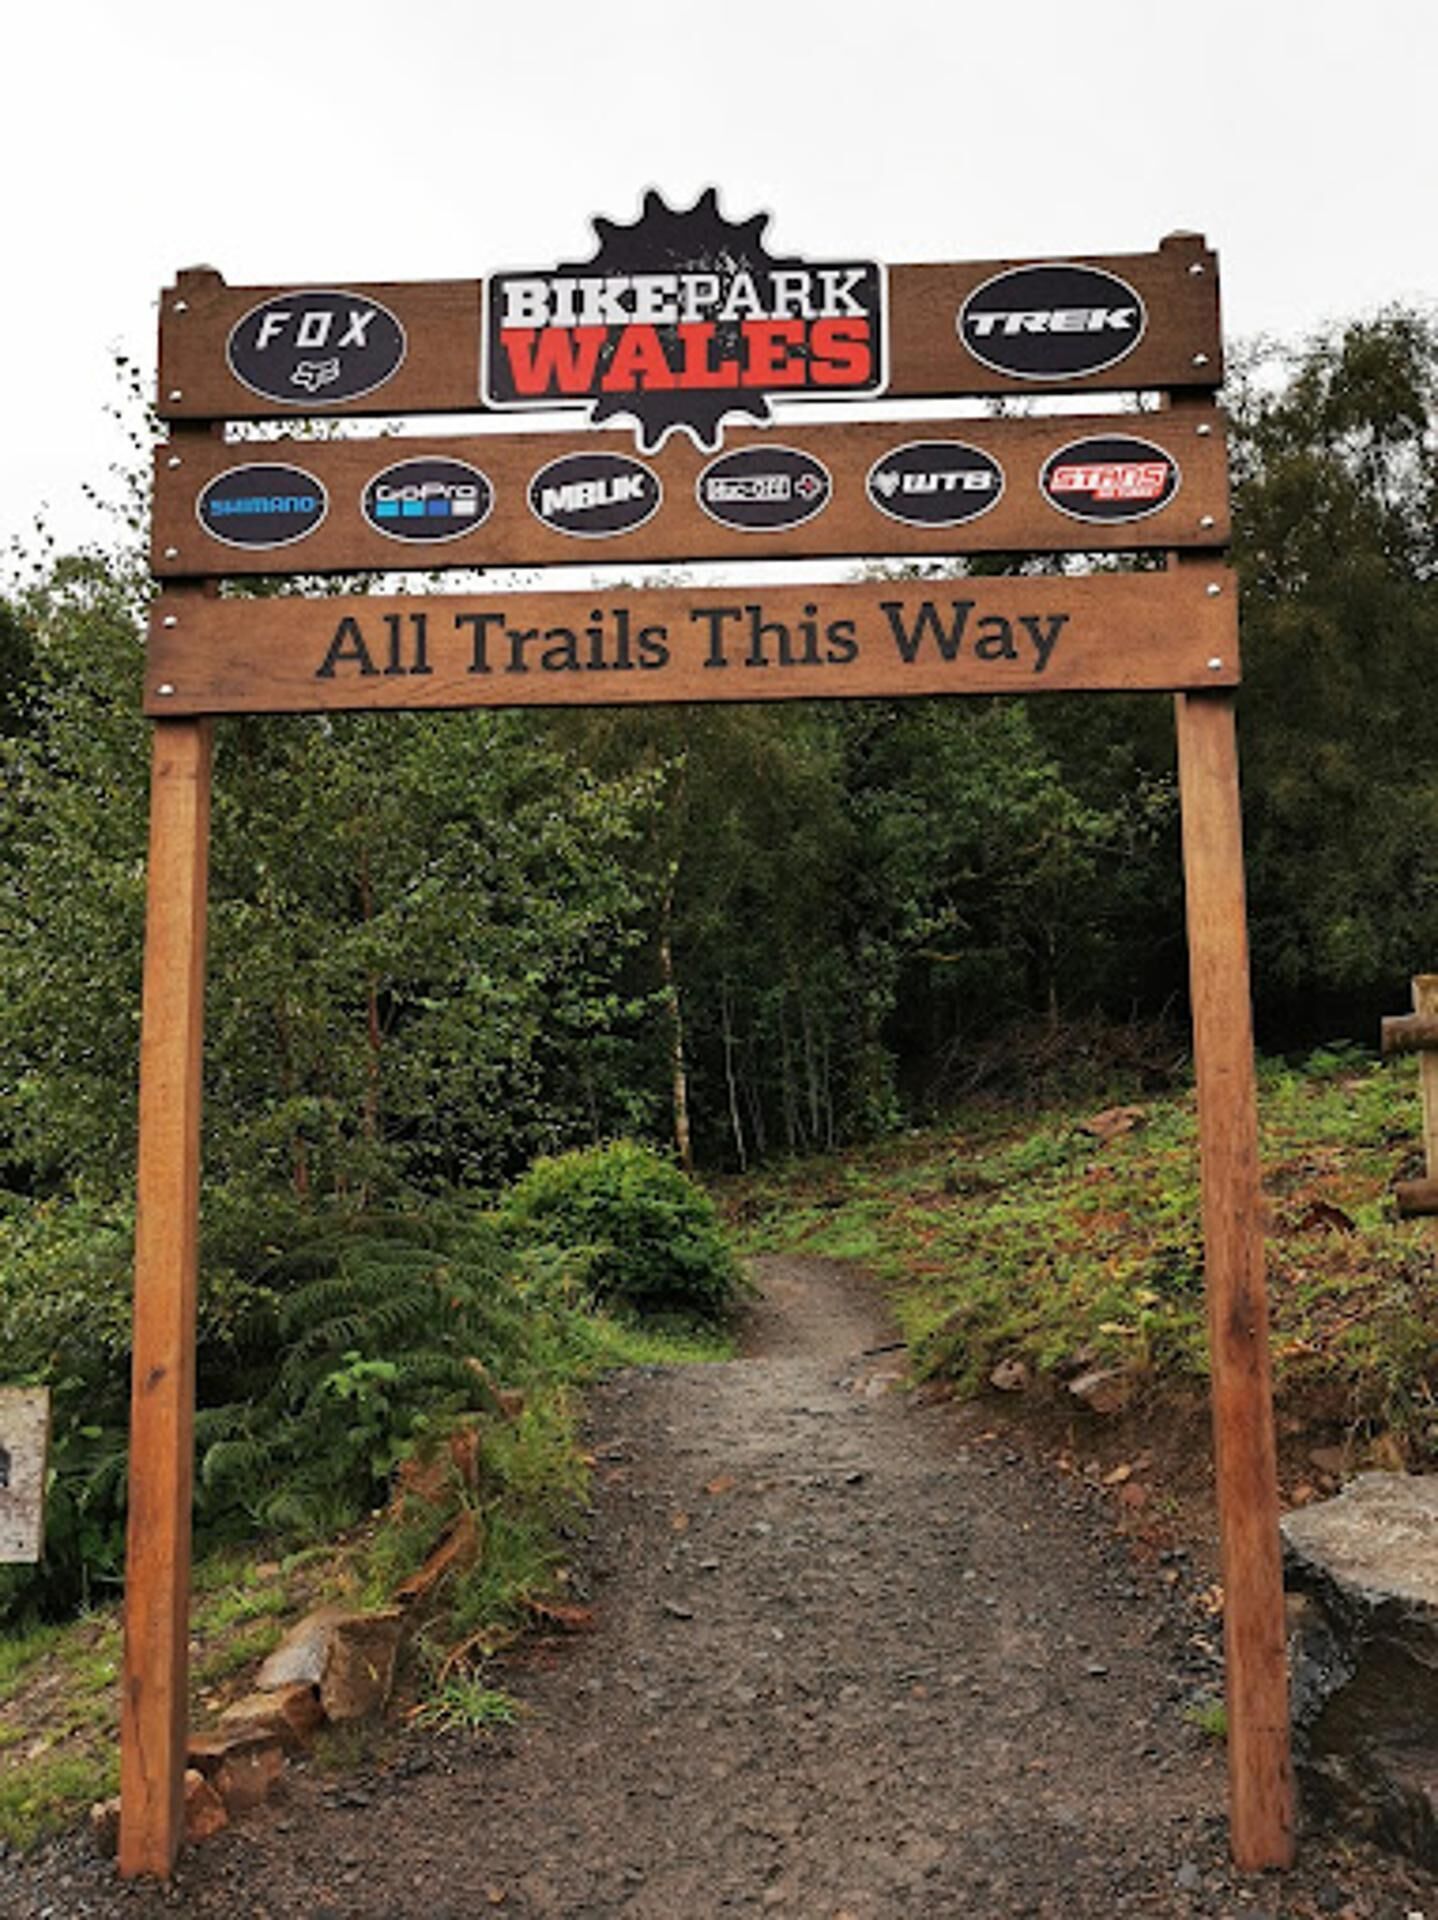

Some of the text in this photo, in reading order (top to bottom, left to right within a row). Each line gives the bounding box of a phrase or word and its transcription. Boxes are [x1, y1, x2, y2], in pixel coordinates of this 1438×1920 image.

[502, 270, 869, 329] BIKEPARK
[255, 311, 376, 350] FOX
[967, 307, 1137, 336] TREK
[500, 319, 872, 395] WALES
[375, 482, 477, 502] GoPro
[541, 473, 646, 516] MBUK
[902, 470, 992, 494] WTB
[210, 496, 316, 517] SHIMANO
[315, 600, 1070, 678] All Trails This Way
